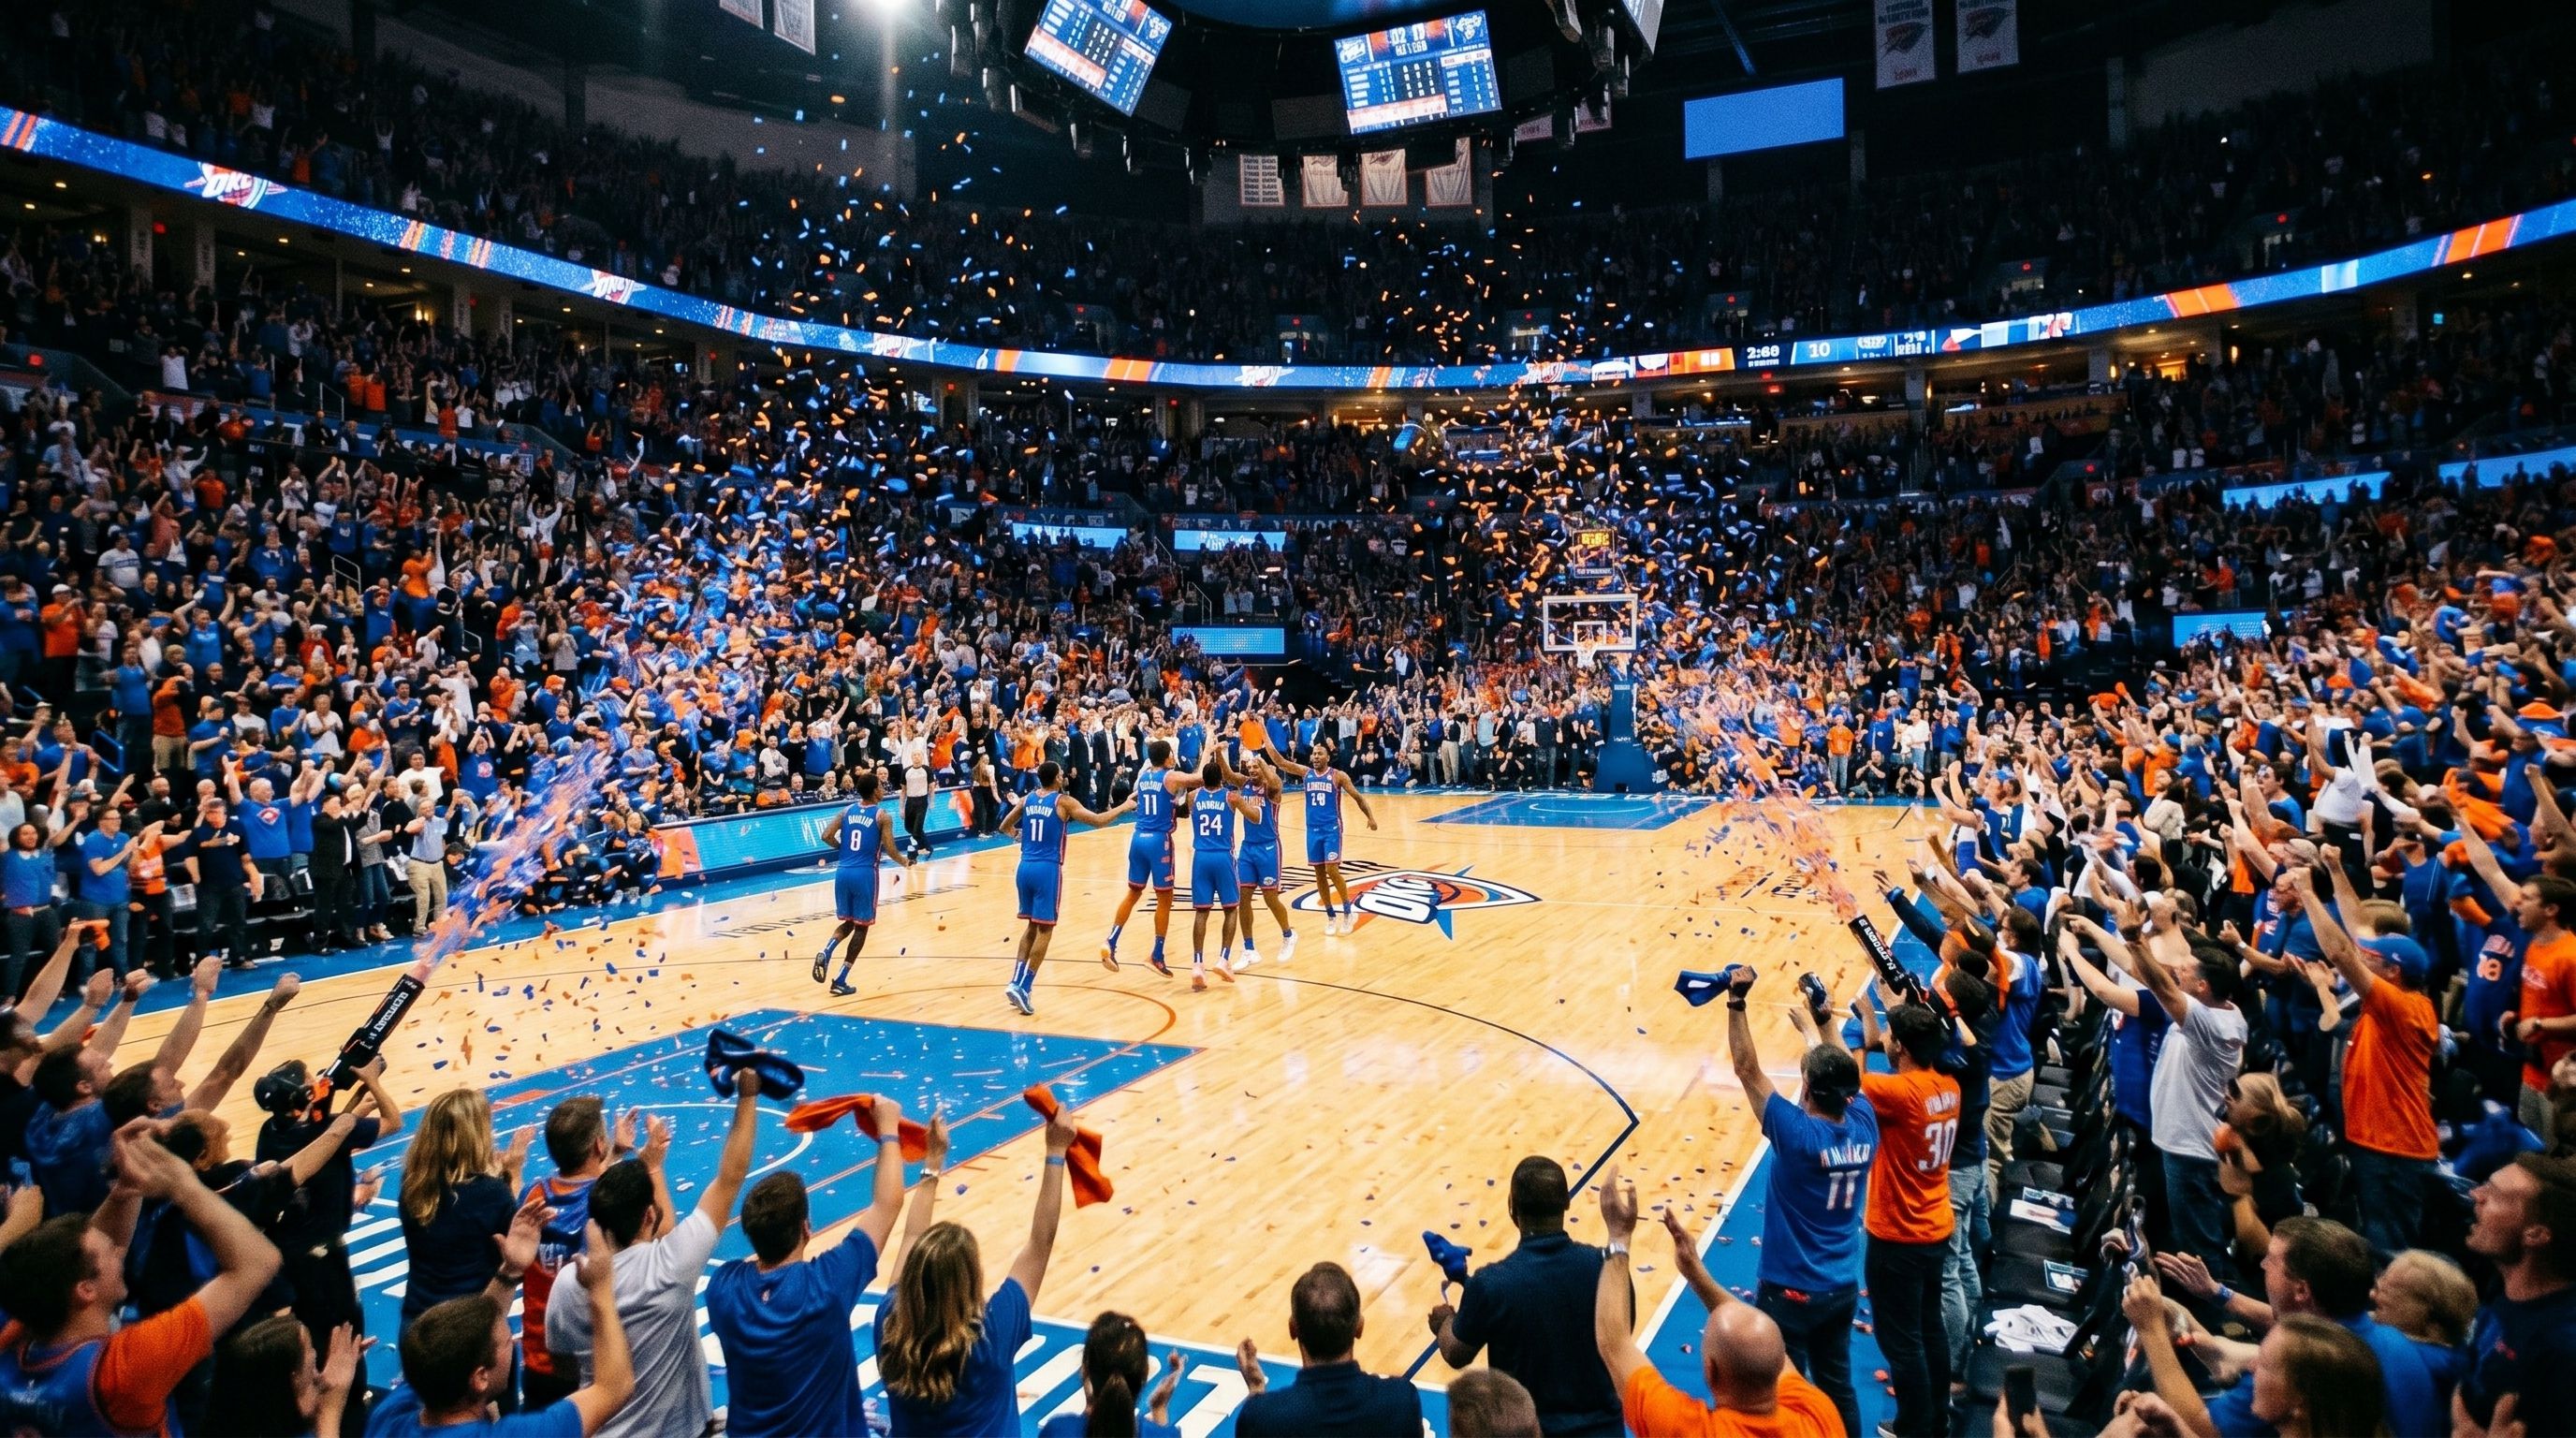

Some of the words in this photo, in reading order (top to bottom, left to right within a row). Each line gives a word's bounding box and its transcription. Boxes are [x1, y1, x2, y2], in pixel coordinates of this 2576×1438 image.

[1808, 342, 1831, 359] 10
[1143, 794, 1158, 815] 11
[1030, 818, 1044, 842] 11
[1199, 814, 1222, 836] 24
[850, 829, 862, 851] 8
[1919, 1119, 1957, 1170] 30
